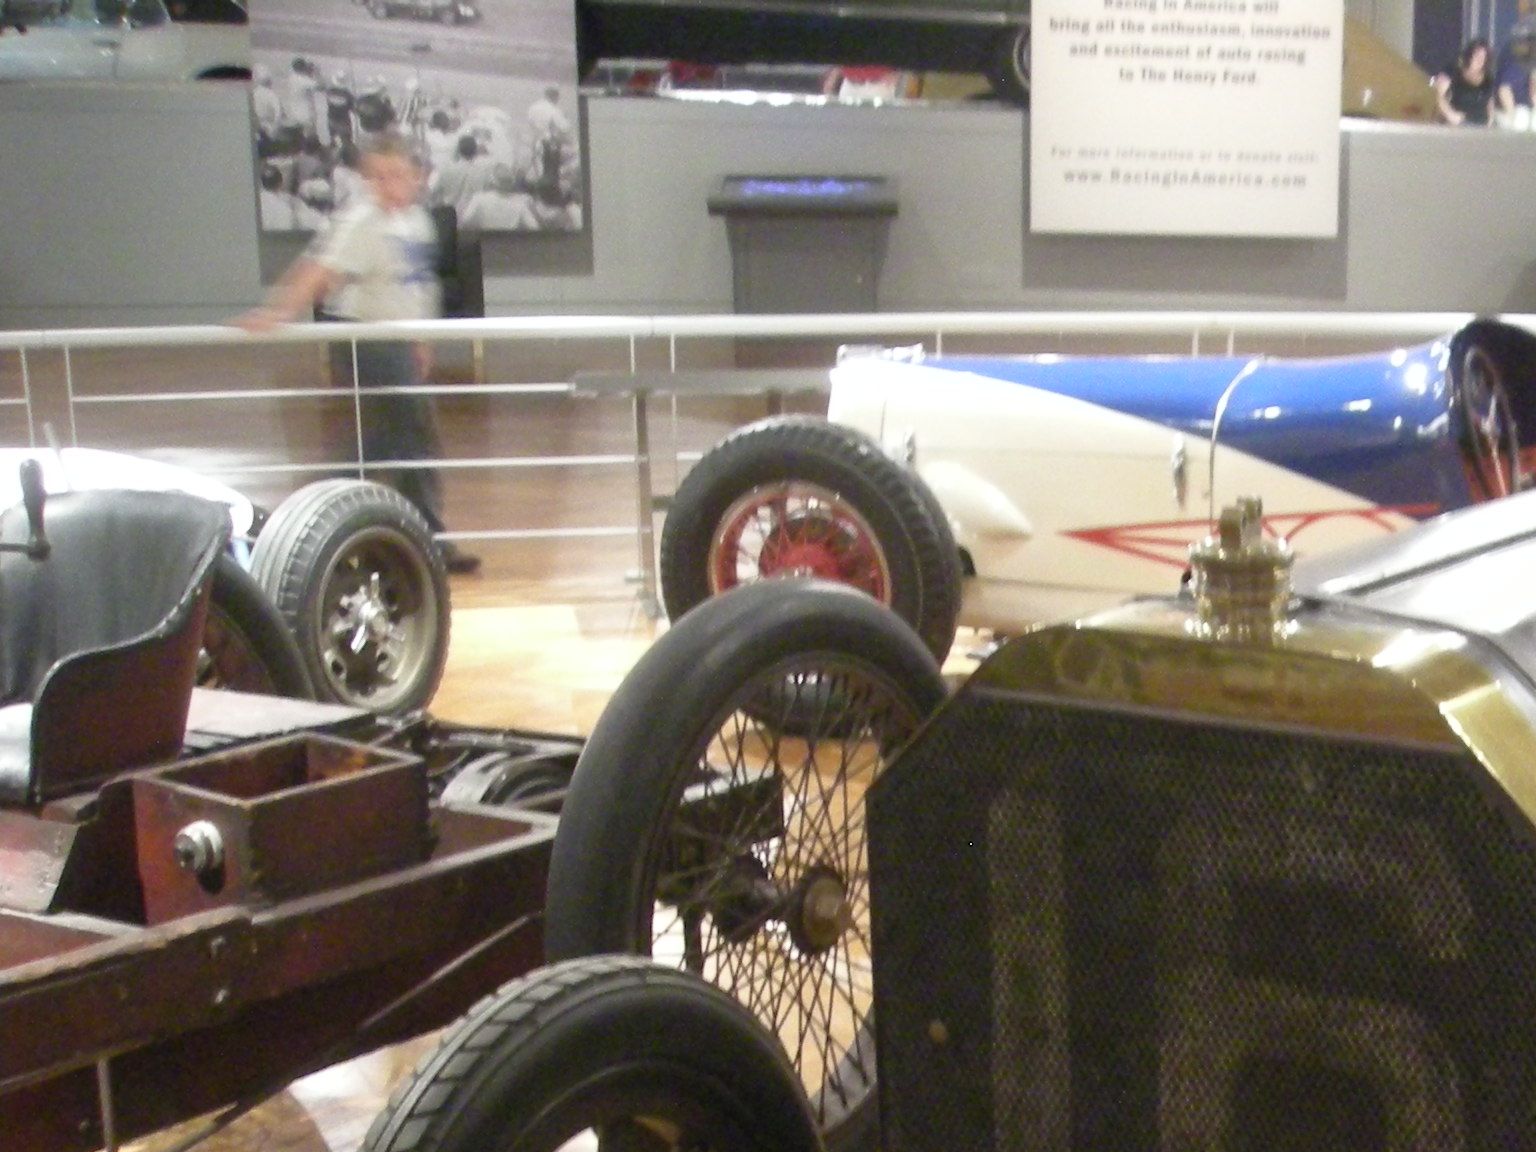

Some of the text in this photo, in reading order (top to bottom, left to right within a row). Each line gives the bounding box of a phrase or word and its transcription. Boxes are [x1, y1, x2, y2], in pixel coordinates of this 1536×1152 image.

[1184, 0, 1247, 13] America
[1253, 0, 1280, 13] will
[1049, 17, 1091, 35] bring
[1096, 19, 1116, 33] all
[1121, 20, 1145, 34] the
[1250, 23, 1332, 39] innovation
[1069, 43, 1307, 65] and excitement of auto racing
[1118, 68, 1135, 81] to
[1140, 68, 1168, 82] The
[1173, 68, 1218, 87] Henry
[1050, 146, 1073, 158] For
[1078, 149, 1111, 160] more
[1115, 148, 1194, 161] information
[1217, 149, 1232, 161] to
[1236, 149, 1282, 163] donate
